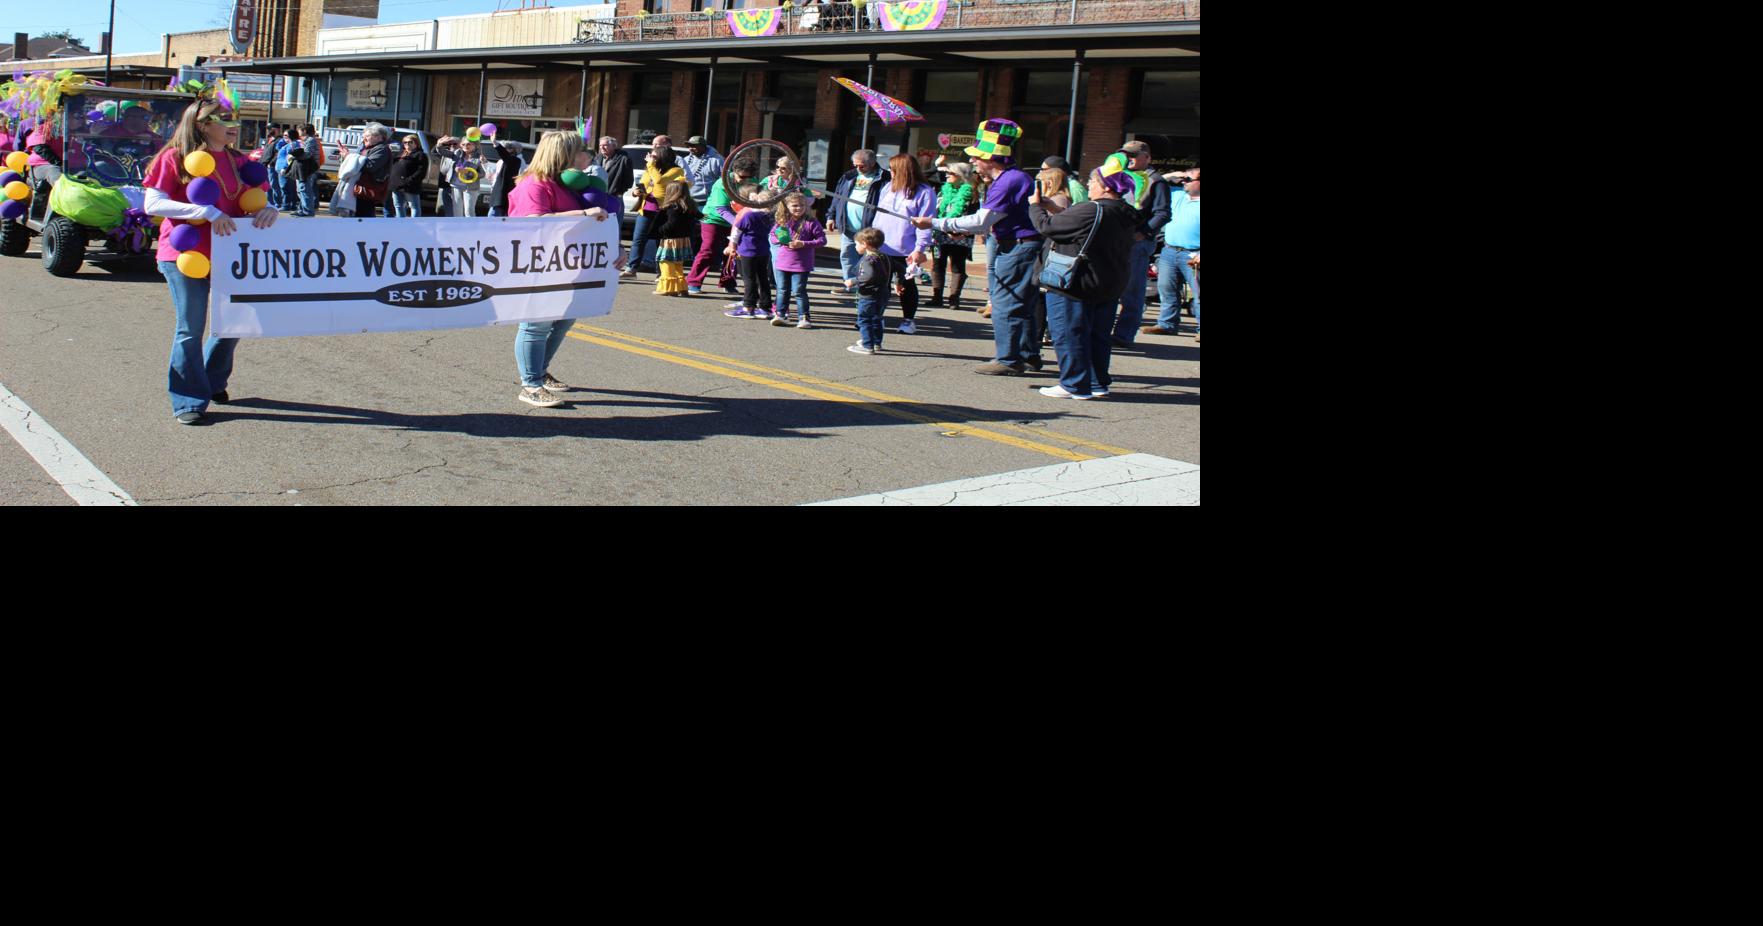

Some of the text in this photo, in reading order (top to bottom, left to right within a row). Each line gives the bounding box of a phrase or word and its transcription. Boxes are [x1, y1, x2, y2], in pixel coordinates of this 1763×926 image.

[231, 239, 609, 280] JUNIOR WOMEN'S LEAGUE
[388, 286, 483, 303] EST 1962
